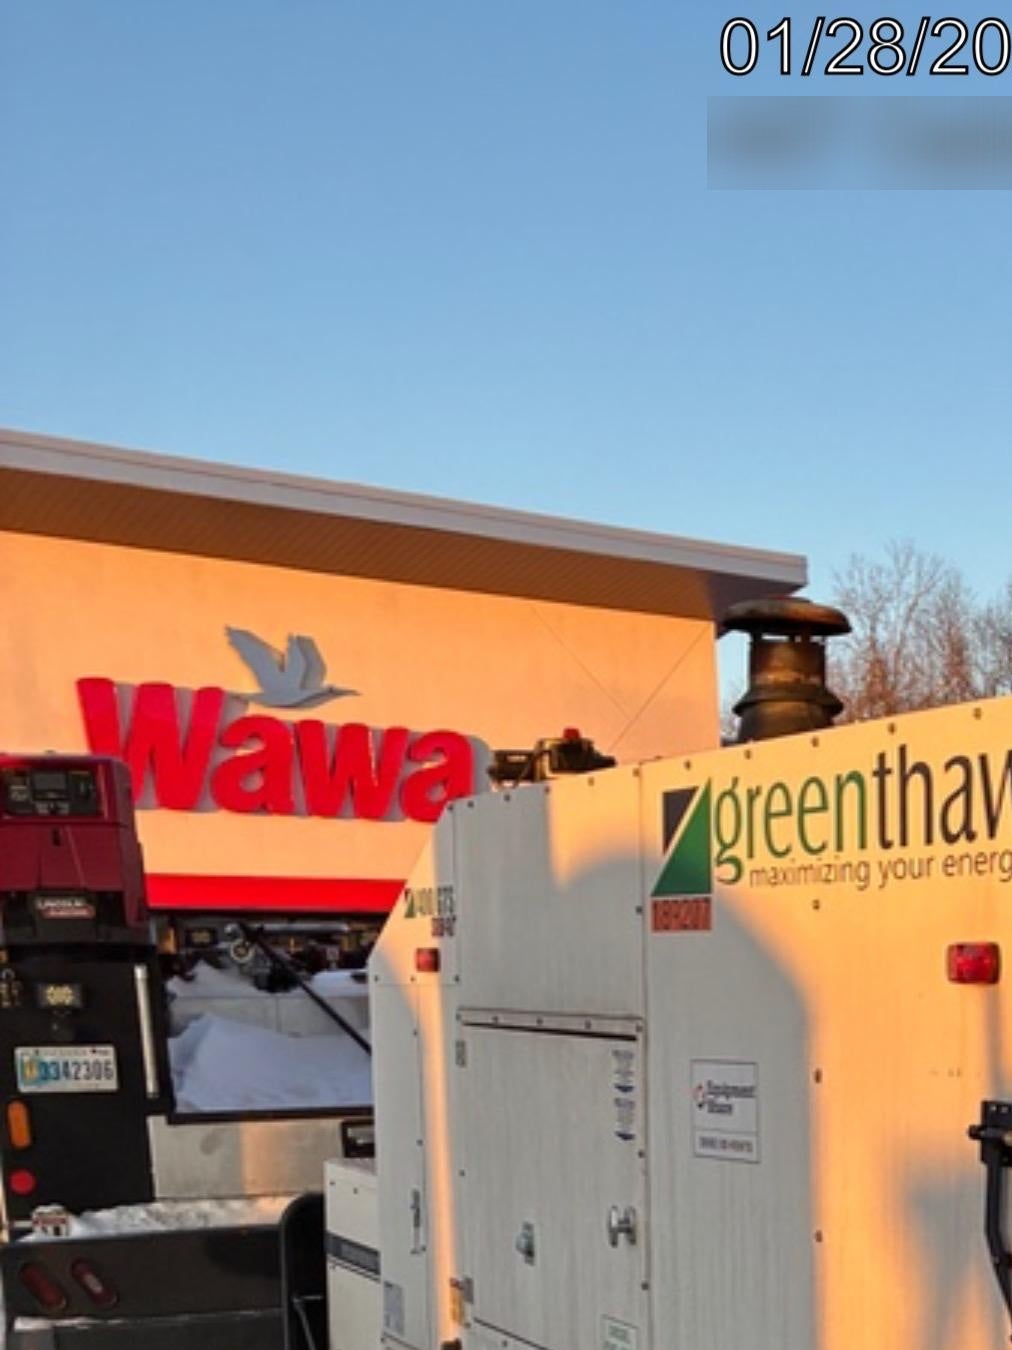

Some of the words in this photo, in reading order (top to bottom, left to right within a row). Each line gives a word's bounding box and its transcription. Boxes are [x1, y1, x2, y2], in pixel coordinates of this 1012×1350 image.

[76, 677, 474, 823] Wawa
[748, 856, 871, 891] maximizing
[876, 855, 933, 888] your
